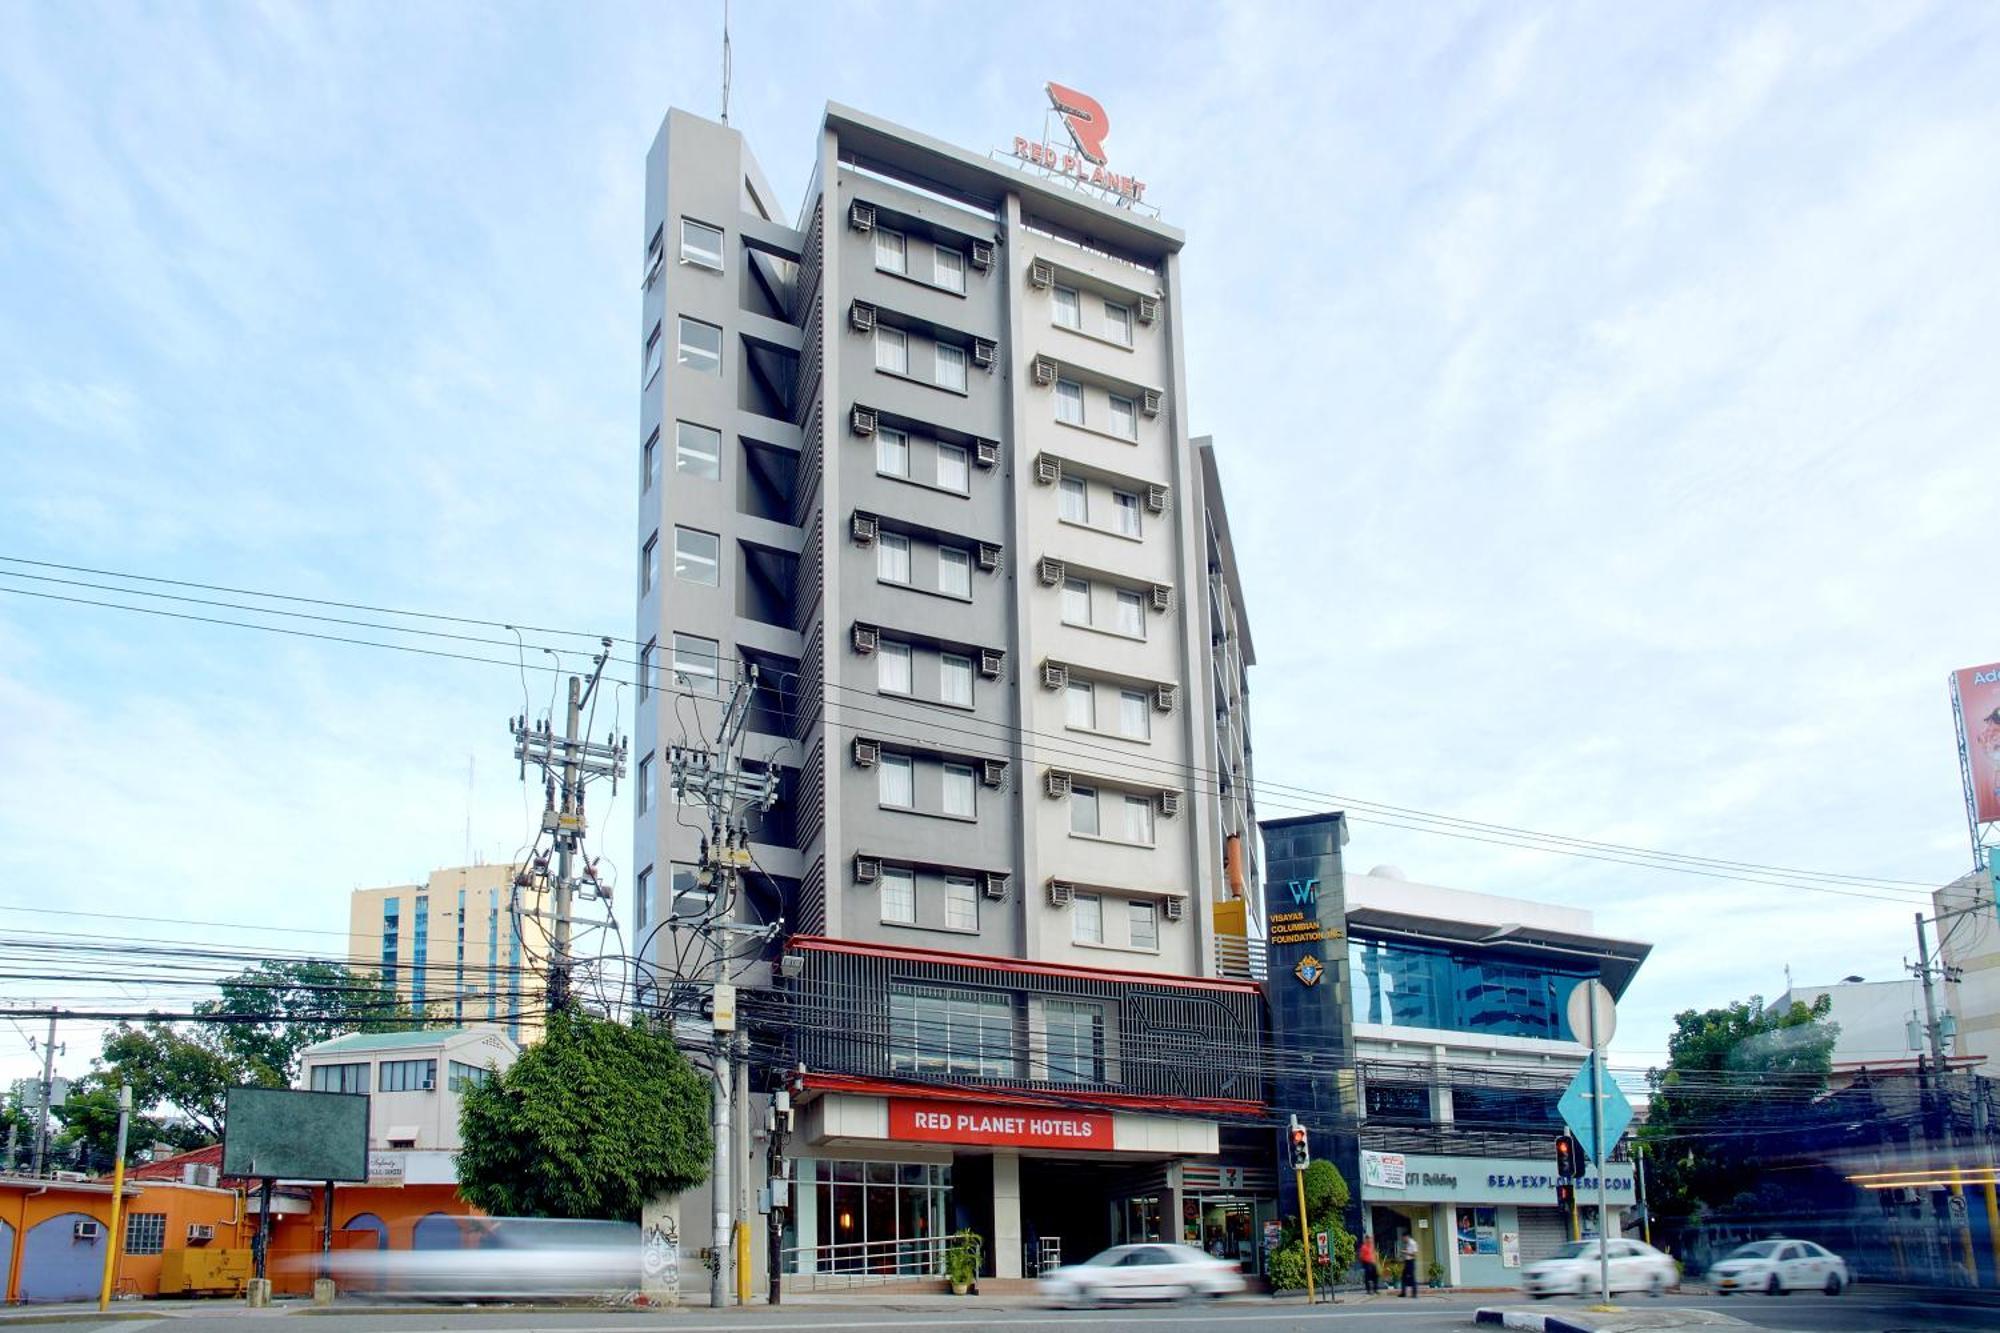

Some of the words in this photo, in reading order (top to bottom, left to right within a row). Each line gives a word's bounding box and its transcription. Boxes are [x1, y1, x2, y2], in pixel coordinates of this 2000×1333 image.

[1014, 136, 1057, 169] RED
[1063, 154, 1146, 201] PLANET
[1270, 912, 1304, 923] VISAYAS
[1271, 932, 1325, 945] FOUNDATION
[915, 1112, 952, 1129] RED
[957, 1115, 1025, 1134] PLANET
[1030, 1119, 1092, 1137] HOTELS
